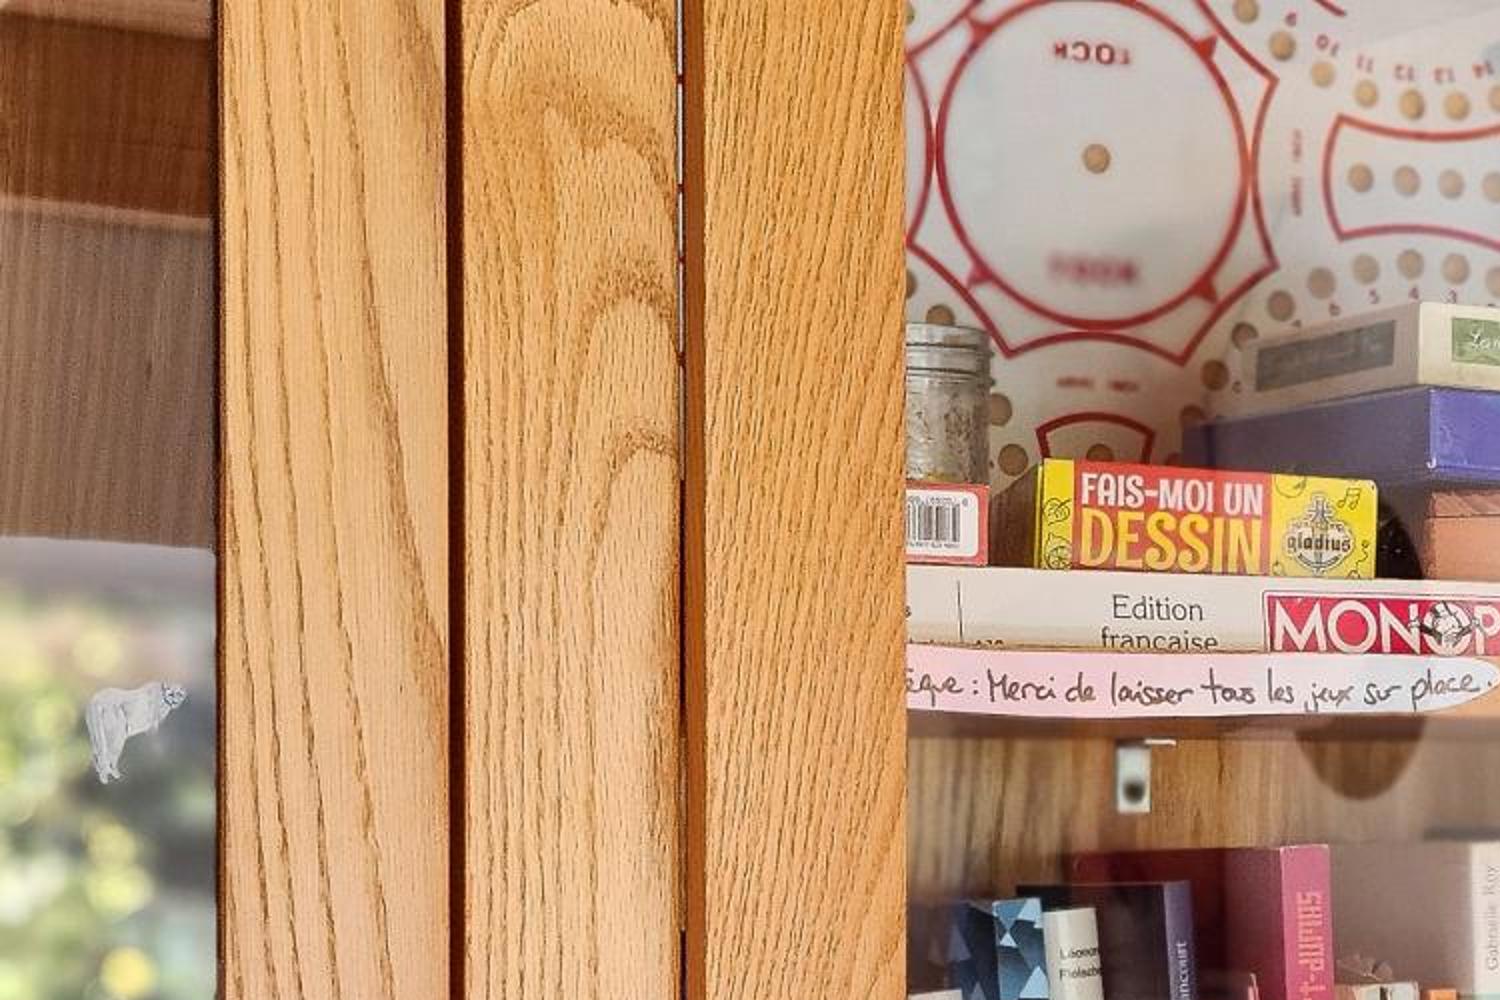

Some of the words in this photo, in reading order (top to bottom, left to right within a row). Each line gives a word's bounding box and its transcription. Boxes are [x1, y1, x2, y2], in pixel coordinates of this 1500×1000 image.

[1081, 472, 1214, 513] FAIS-MOI
[1223, 482, 1264, 515] UN
[1080, 506, 1262, 577] DESSIN
[1112, 593, 1204, 621] Edition
[987, 667, 1057, 702] Merci
[1065, 671, 1098, 702] de
[1267, 667, 1295, 702] les
[1364, 683, 1402, 704] sur
